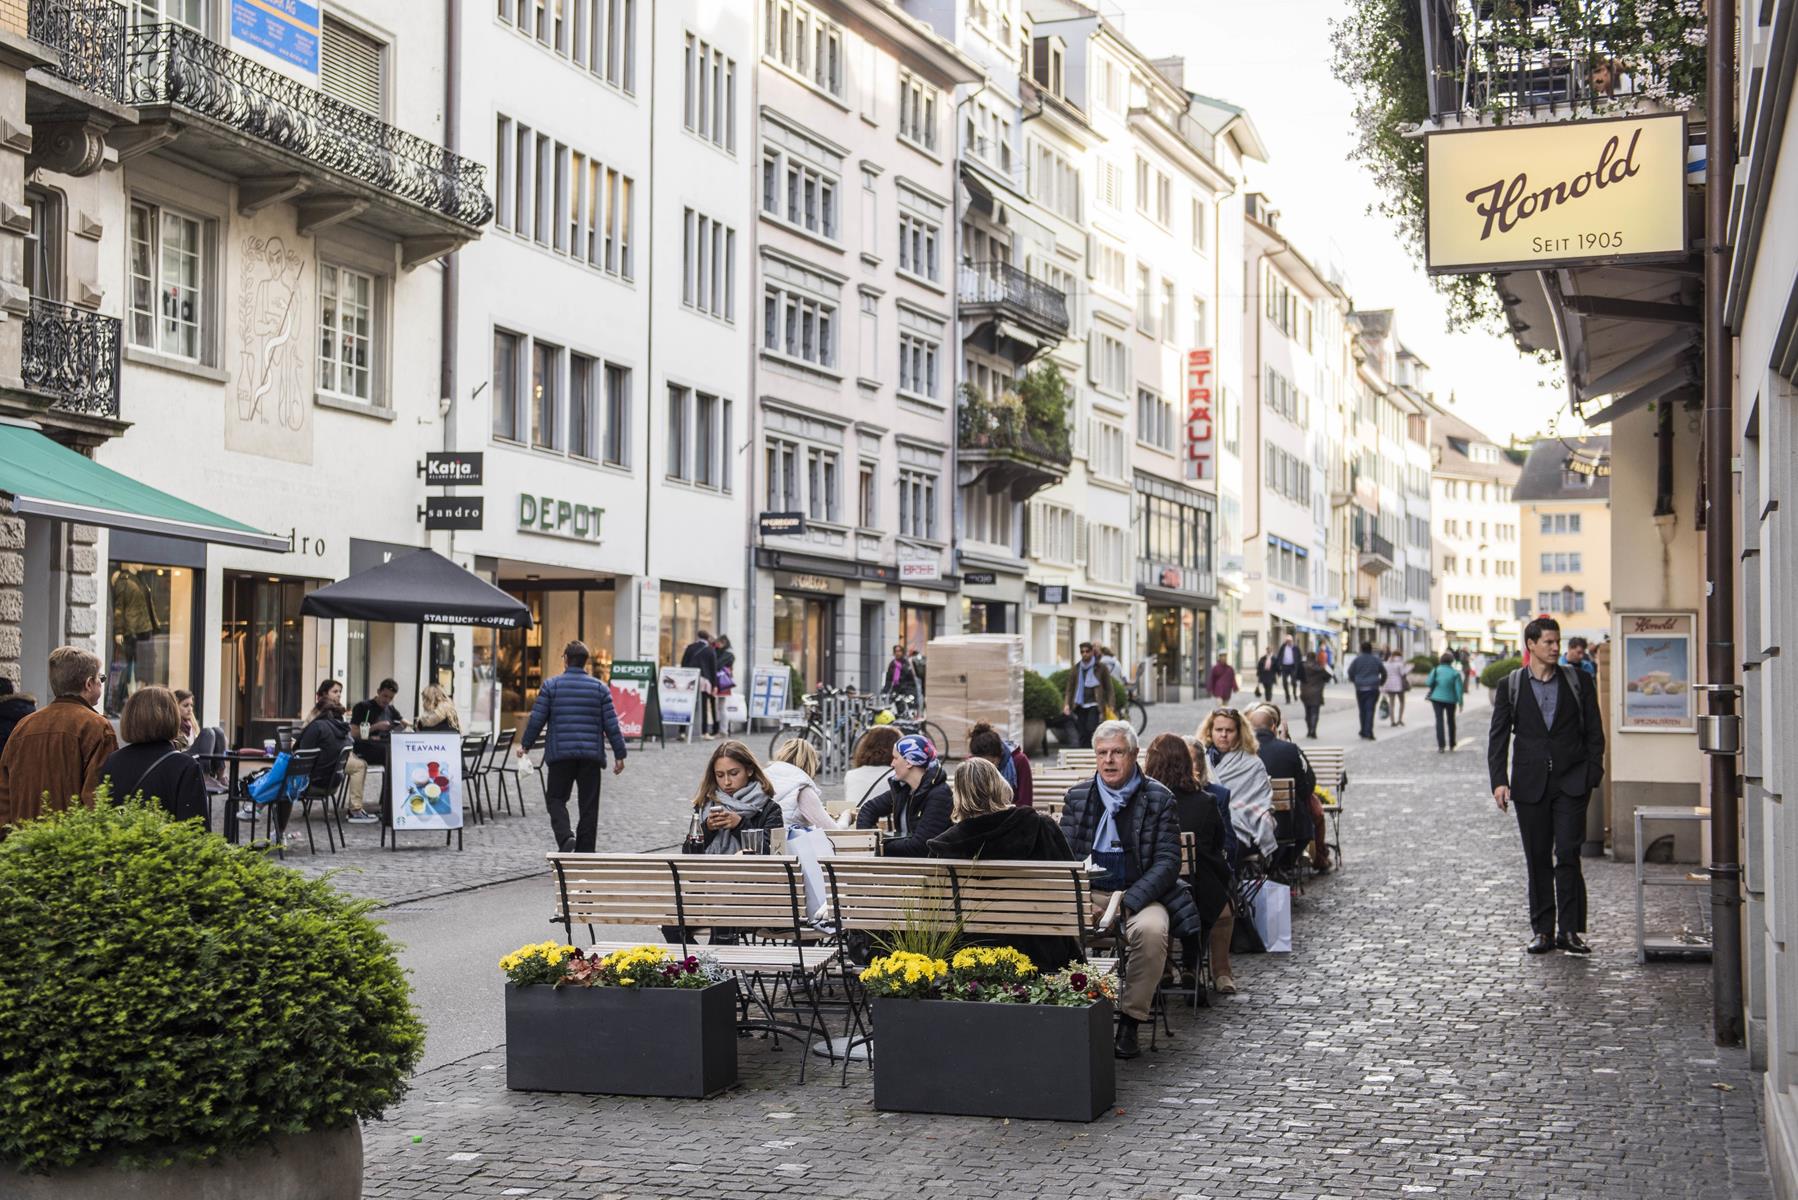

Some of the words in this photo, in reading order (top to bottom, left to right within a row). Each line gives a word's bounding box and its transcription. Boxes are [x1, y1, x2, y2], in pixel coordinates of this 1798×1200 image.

[1466, 128, 1642, 241] Honold
[1532, 237, 1569, 253] SEIT
[1578, 232, 1623, 250] 1905
[1188, 350, 1211, 480] STRÄULI
[429, 456, 471, 479] Katja
[428, 507, 480, 518] sandro
[519, 493, 605, 538] DEPOT
[481, 617, 516, 627] COFFEE
[1635, 617, 1677, 632] Honold
[613, 665, 650, 673] DEPOT
